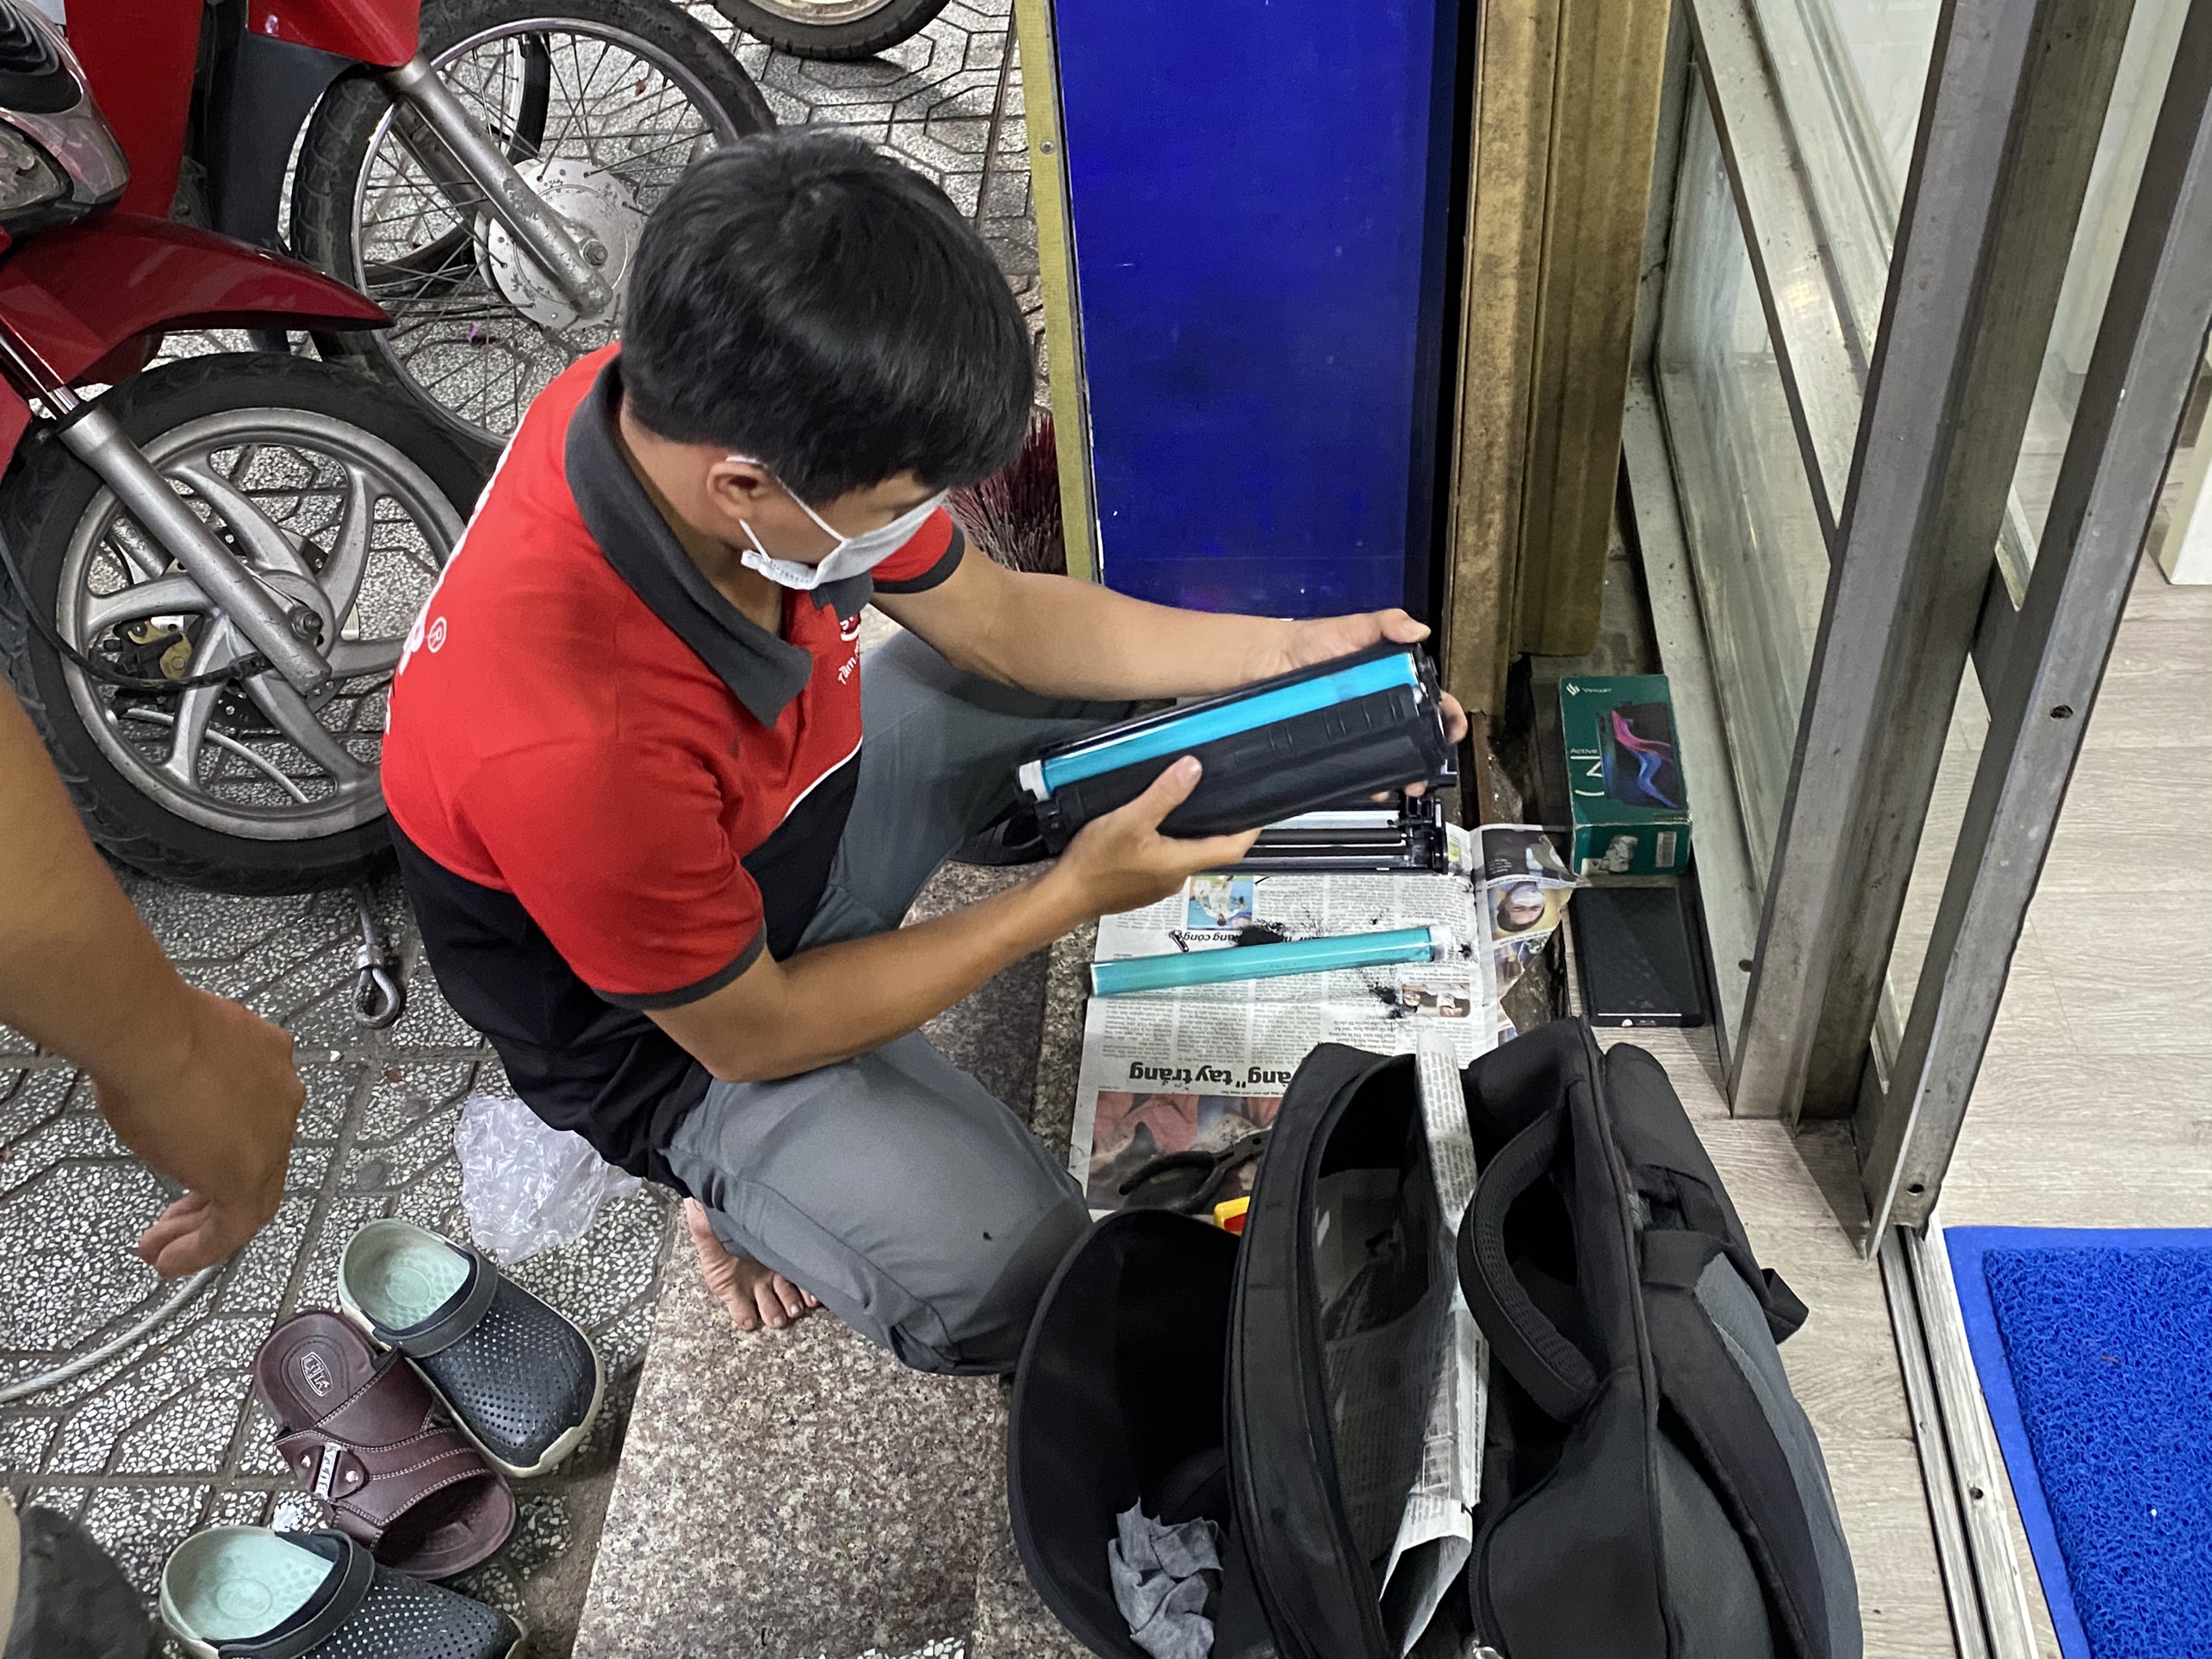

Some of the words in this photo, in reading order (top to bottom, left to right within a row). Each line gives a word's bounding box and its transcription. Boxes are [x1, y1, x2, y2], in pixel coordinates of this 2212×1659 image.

[1129, 1061, 1193, 1087] trắng
[1195, 1065, 1233, 1084] tay
[1235, 1066, 1291, 1089] àng"
